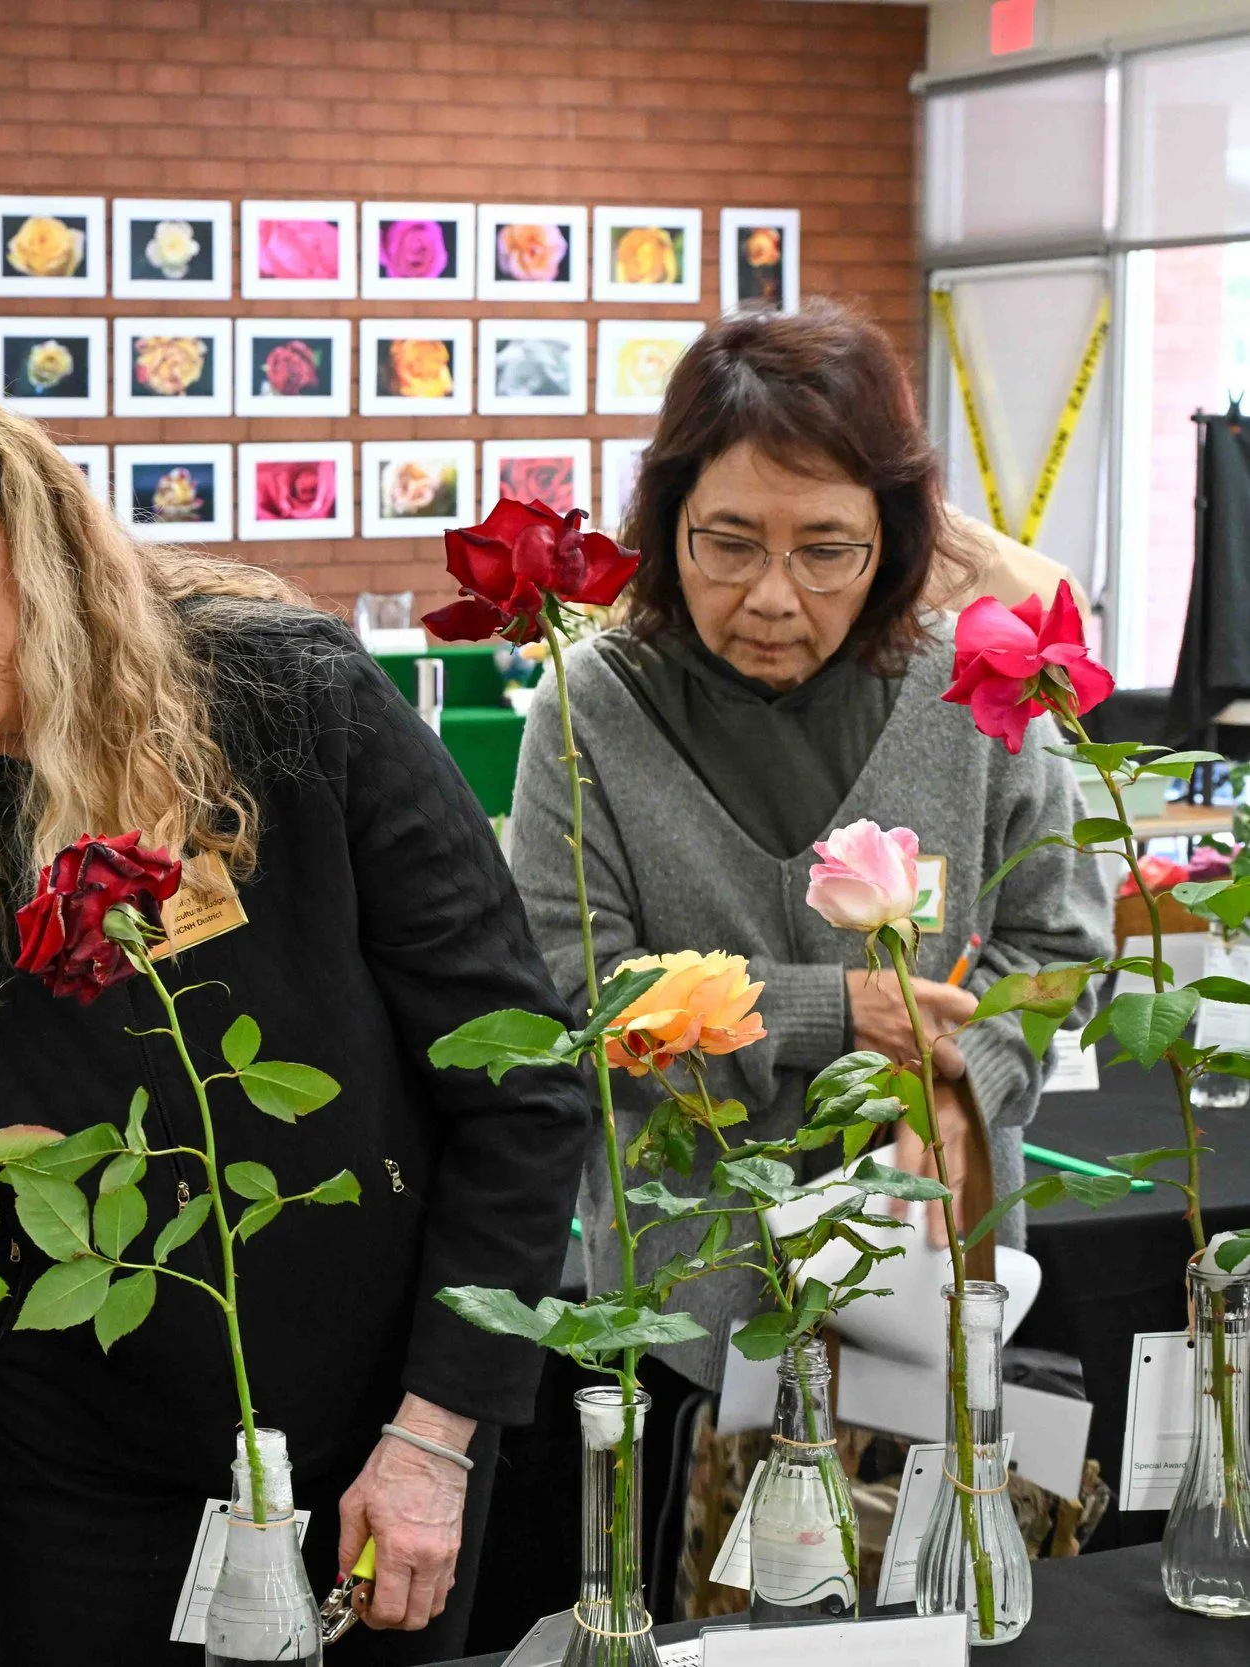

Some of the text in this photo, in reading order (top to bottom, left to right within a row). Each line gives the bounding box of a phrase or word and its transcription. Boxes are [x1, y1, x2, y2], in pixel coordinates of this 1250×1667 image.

[204, 896, 227, 910] Judge
[196, 911, 223, 926] District
[1134, 1462, 1162, 1470] Special
